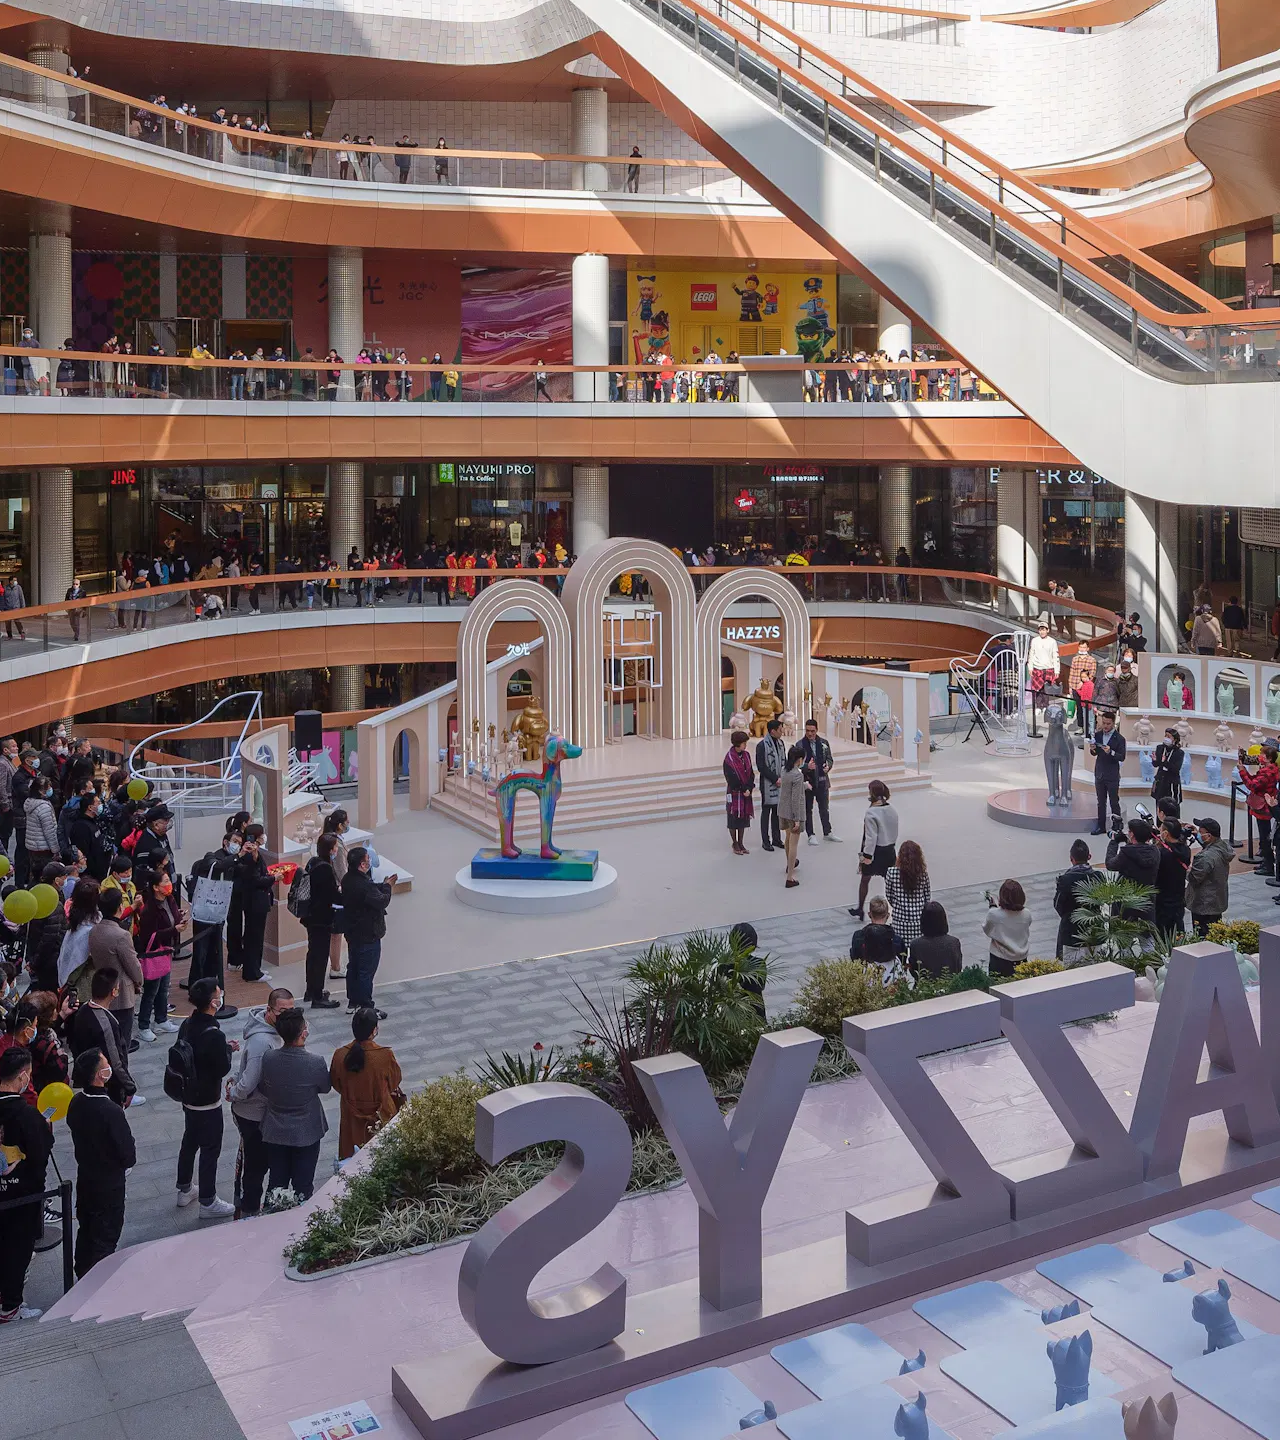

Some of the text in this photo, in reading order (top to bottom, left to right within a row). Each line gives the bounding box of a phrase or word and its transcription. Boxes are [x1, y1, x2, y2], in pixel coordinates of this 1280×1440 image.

[398, 291, 424, 301] JGC
[693, 292, 715, 302] LEGO
[363, 331, 382, 344] LL
[458, 464, 502, 474] NAYUKI
[1067, 469, 1086, 484] &
[738, 498, 753, 508] Tims
[726, 625, 780, 640] HAZZYS
[506, 643, 530, 656] 久光
